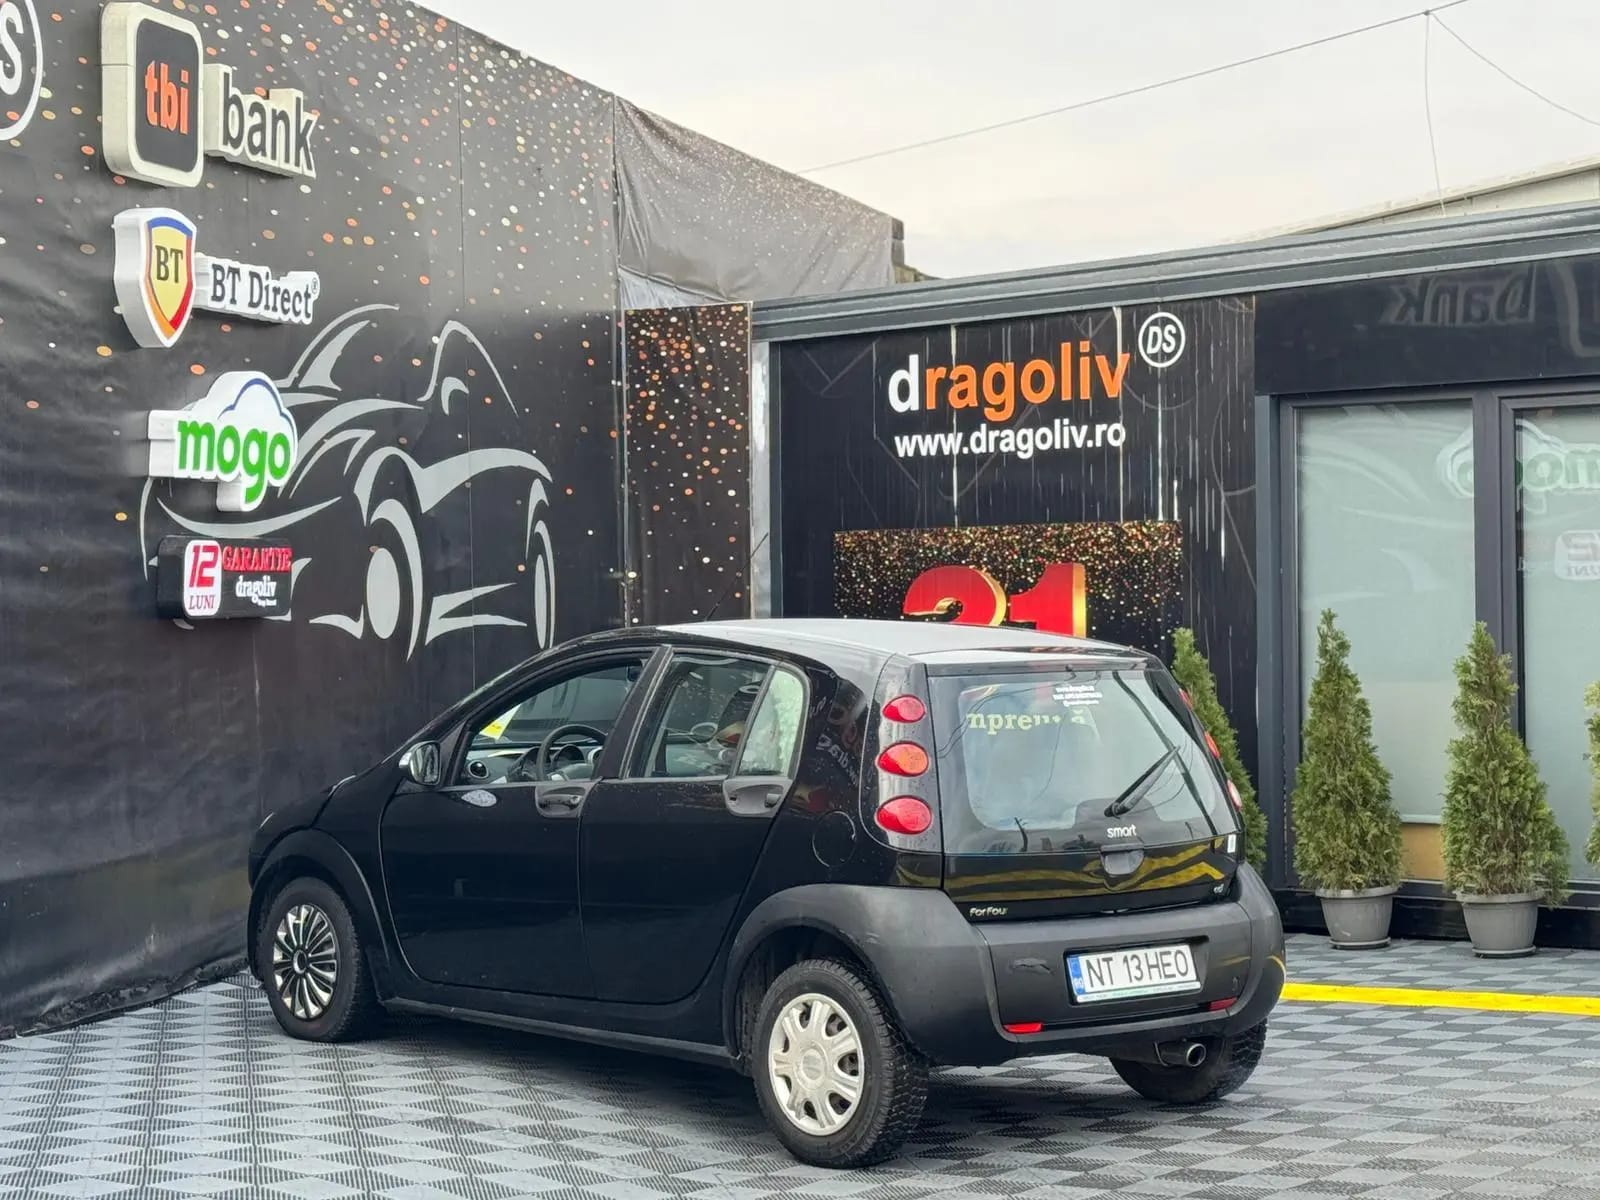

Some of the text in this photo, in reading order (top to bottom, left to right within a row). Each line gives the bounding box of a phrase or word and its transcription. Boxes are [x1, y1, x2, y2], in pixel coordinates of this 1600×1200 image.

[144, 60, 315, 171] tbi bank
[155, 245, 183, 284] BT
[211, 263, 241, 305] BT
[1145, 324, 1177, 355] DS
[888, 340, 1131, 422] dragoliv
[894, 418, 1127, 460] www.dragoliv.ro
[177, 419, 292, 505] mogo
[189, 545, 219, 588] 12
[189, 595, 216, 611] LUNI
[235, 575, 277, 604] dragoliv
[1106, 823, 1137, 839] smart
[1085, 956, 1113, 988] NT
